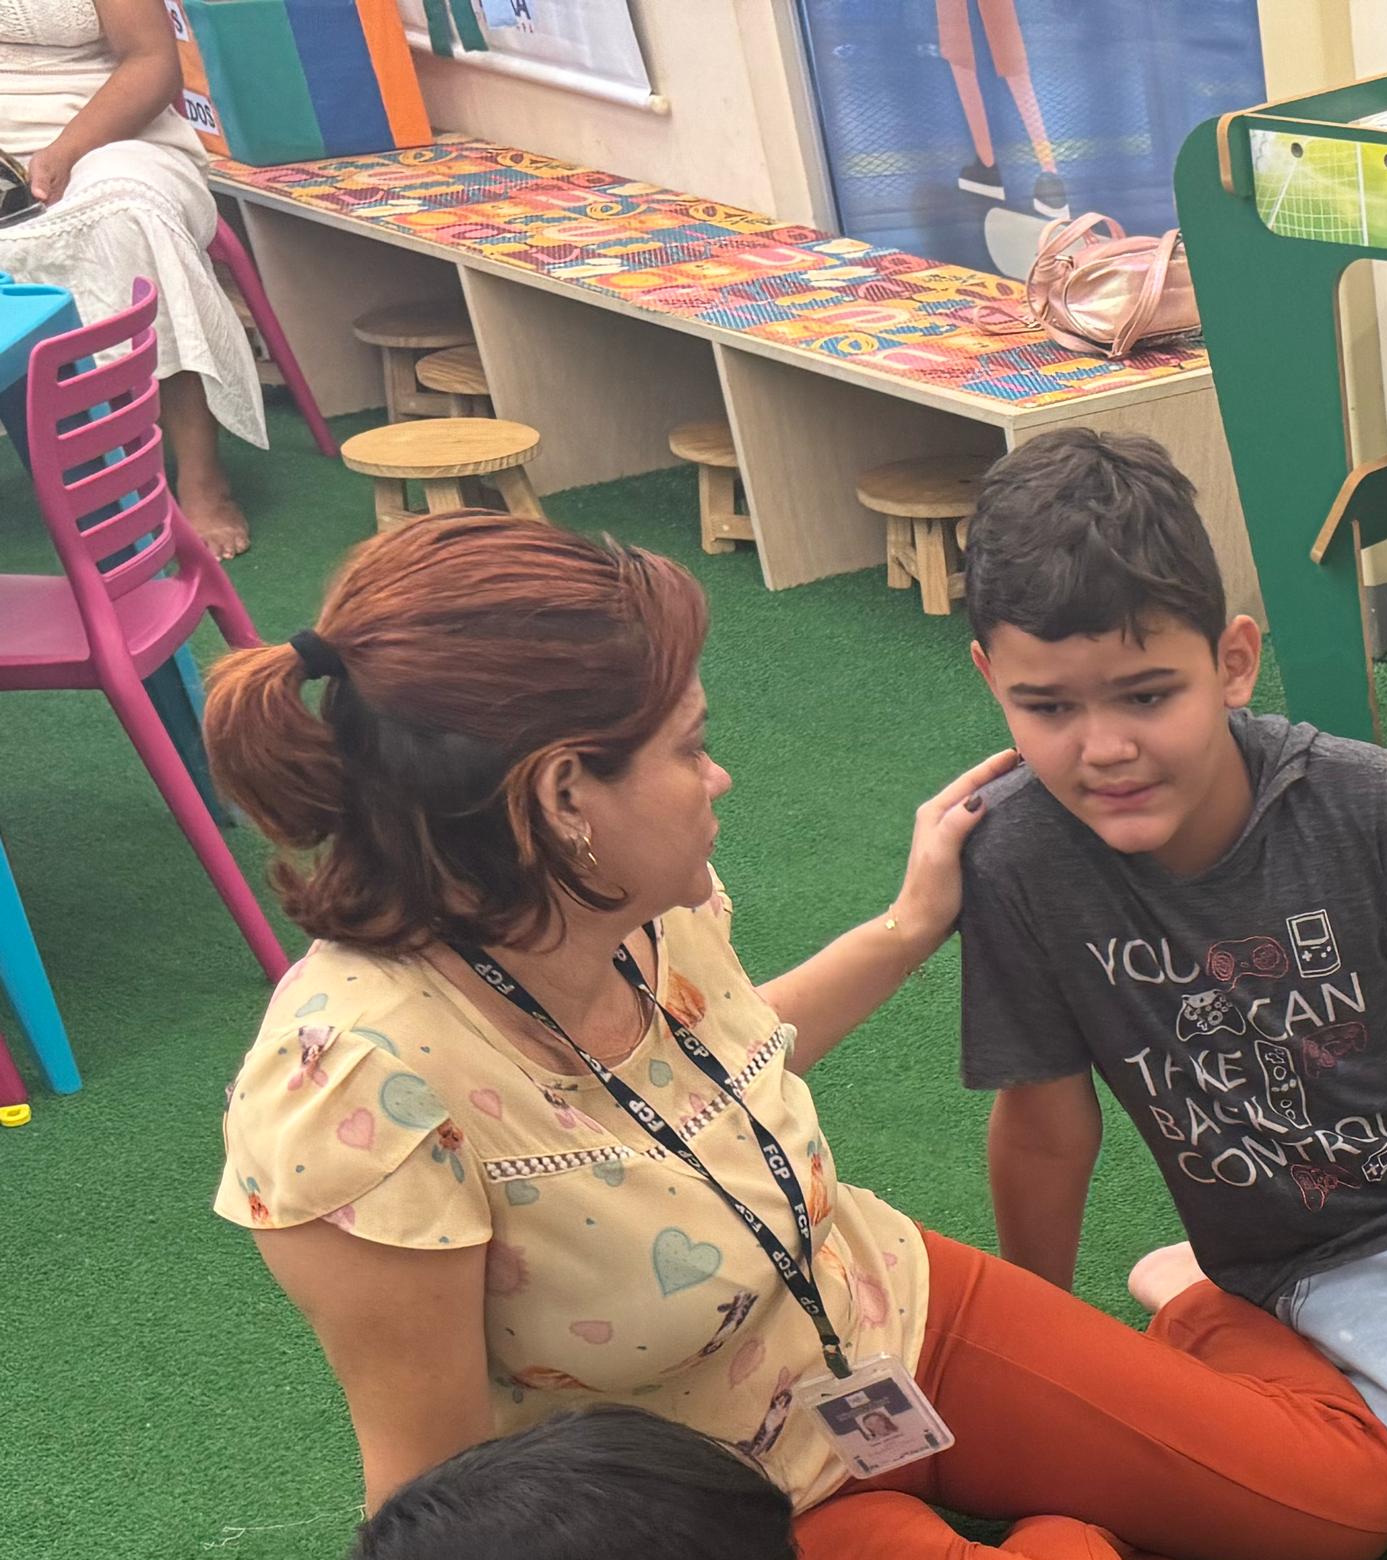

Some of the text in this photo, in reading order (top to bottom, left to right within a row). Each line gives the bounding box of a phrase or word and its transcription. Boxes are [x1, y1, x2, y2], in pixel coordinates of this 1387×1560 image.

[1086, 937, 1200, 986] YOU
[1247, 971, 1367, 1042] CAN
[674, 1026, 710, 1058] FCP
[1124, 1047, 1247, 1097] TAKE
[628, 1099, 666, 1133] FCP
[1149, 1096, 1290, 1146] BACK
[762, 1143, 791, 1181] FCP
[771, 1250, 798, 1280] FCP
[800, 1296, 820, 1315] CP
